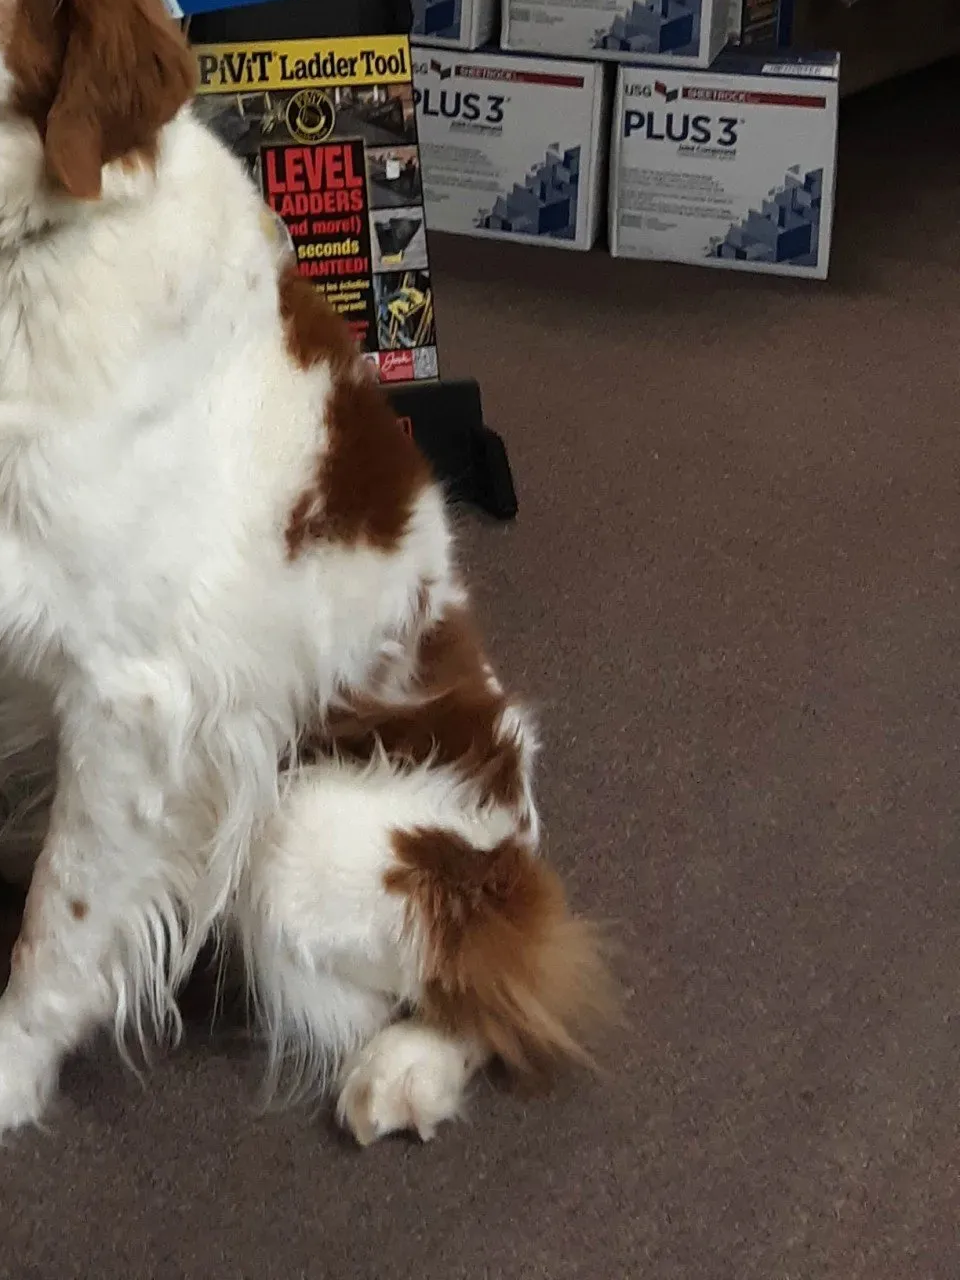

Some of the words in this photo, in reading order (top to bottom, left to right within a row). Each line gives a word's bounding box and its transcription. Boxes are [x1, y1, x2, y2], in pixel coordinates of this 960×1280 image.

[198, 51, 272, 85] PiViT
[279, 55, 359, 81] Ladder
[360, 47, 408, 76] Tool
[624, 84, 652, 99] USG
[485, 95, 505, 124] 3
[623, 109, 712, 144] PLUS
[716, 116, 739, 147] 3
[265, 145, 364, 194] LEVEL
[269, 189, 364, 216] LADDERS
[312, 218, 362, 235] more!)
[297, 237, 360, 259] seconds
